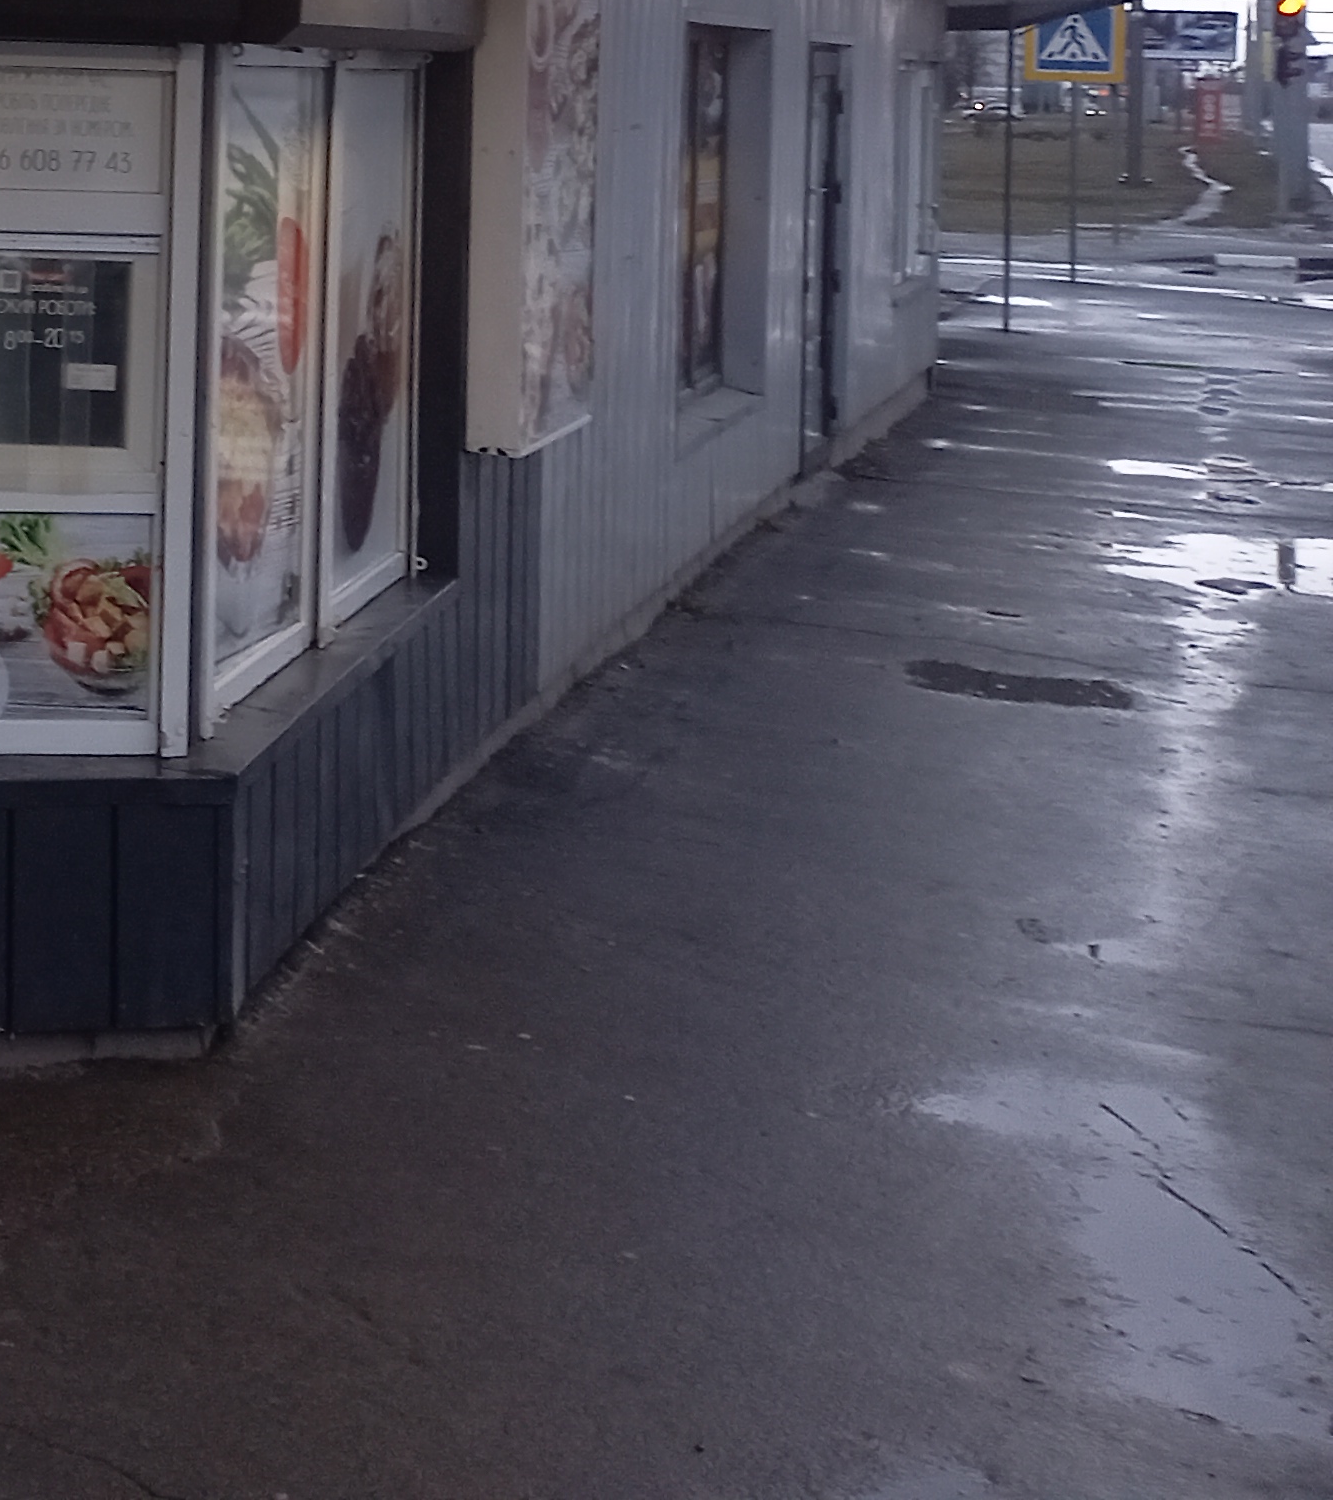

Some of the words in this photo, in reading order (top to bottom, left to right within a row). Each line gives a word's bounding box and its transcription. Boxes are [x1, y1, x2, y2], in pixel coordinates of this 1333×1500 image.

[20, 149, 61, 172] 608
[72, 150, 97, 173] 77
[105, 152, 133, 174] 43
